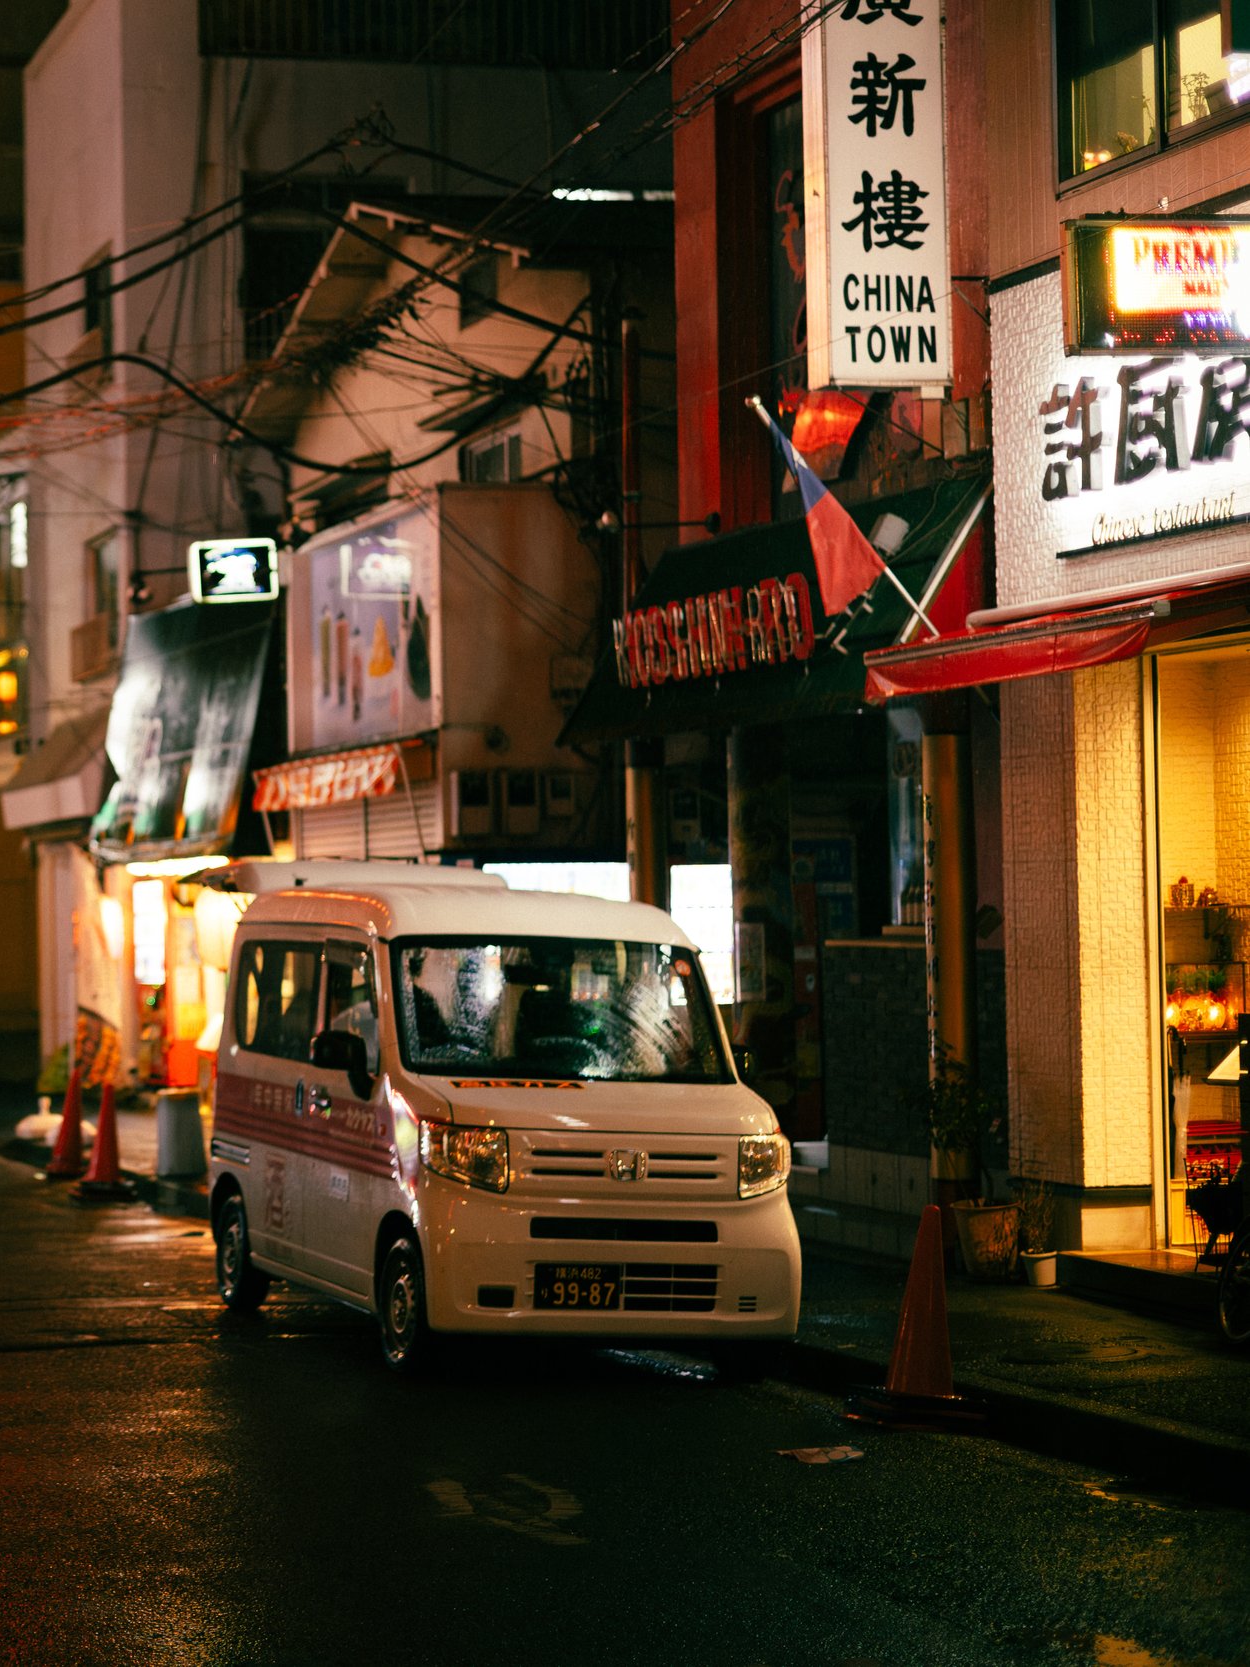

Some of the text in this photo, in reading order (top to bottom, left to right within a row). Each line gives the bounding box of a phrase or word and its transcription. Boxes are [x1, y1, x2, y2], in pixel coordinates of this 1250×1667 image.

[842, 274, 936, 313] CHINA
[847, 325, 938, 364] TOWN
[1091, 491, 1237, 546] Chinese restaurant
[580, 1266, 602, 1280] 482
[552, 1281, 617, 1307] 99-87
